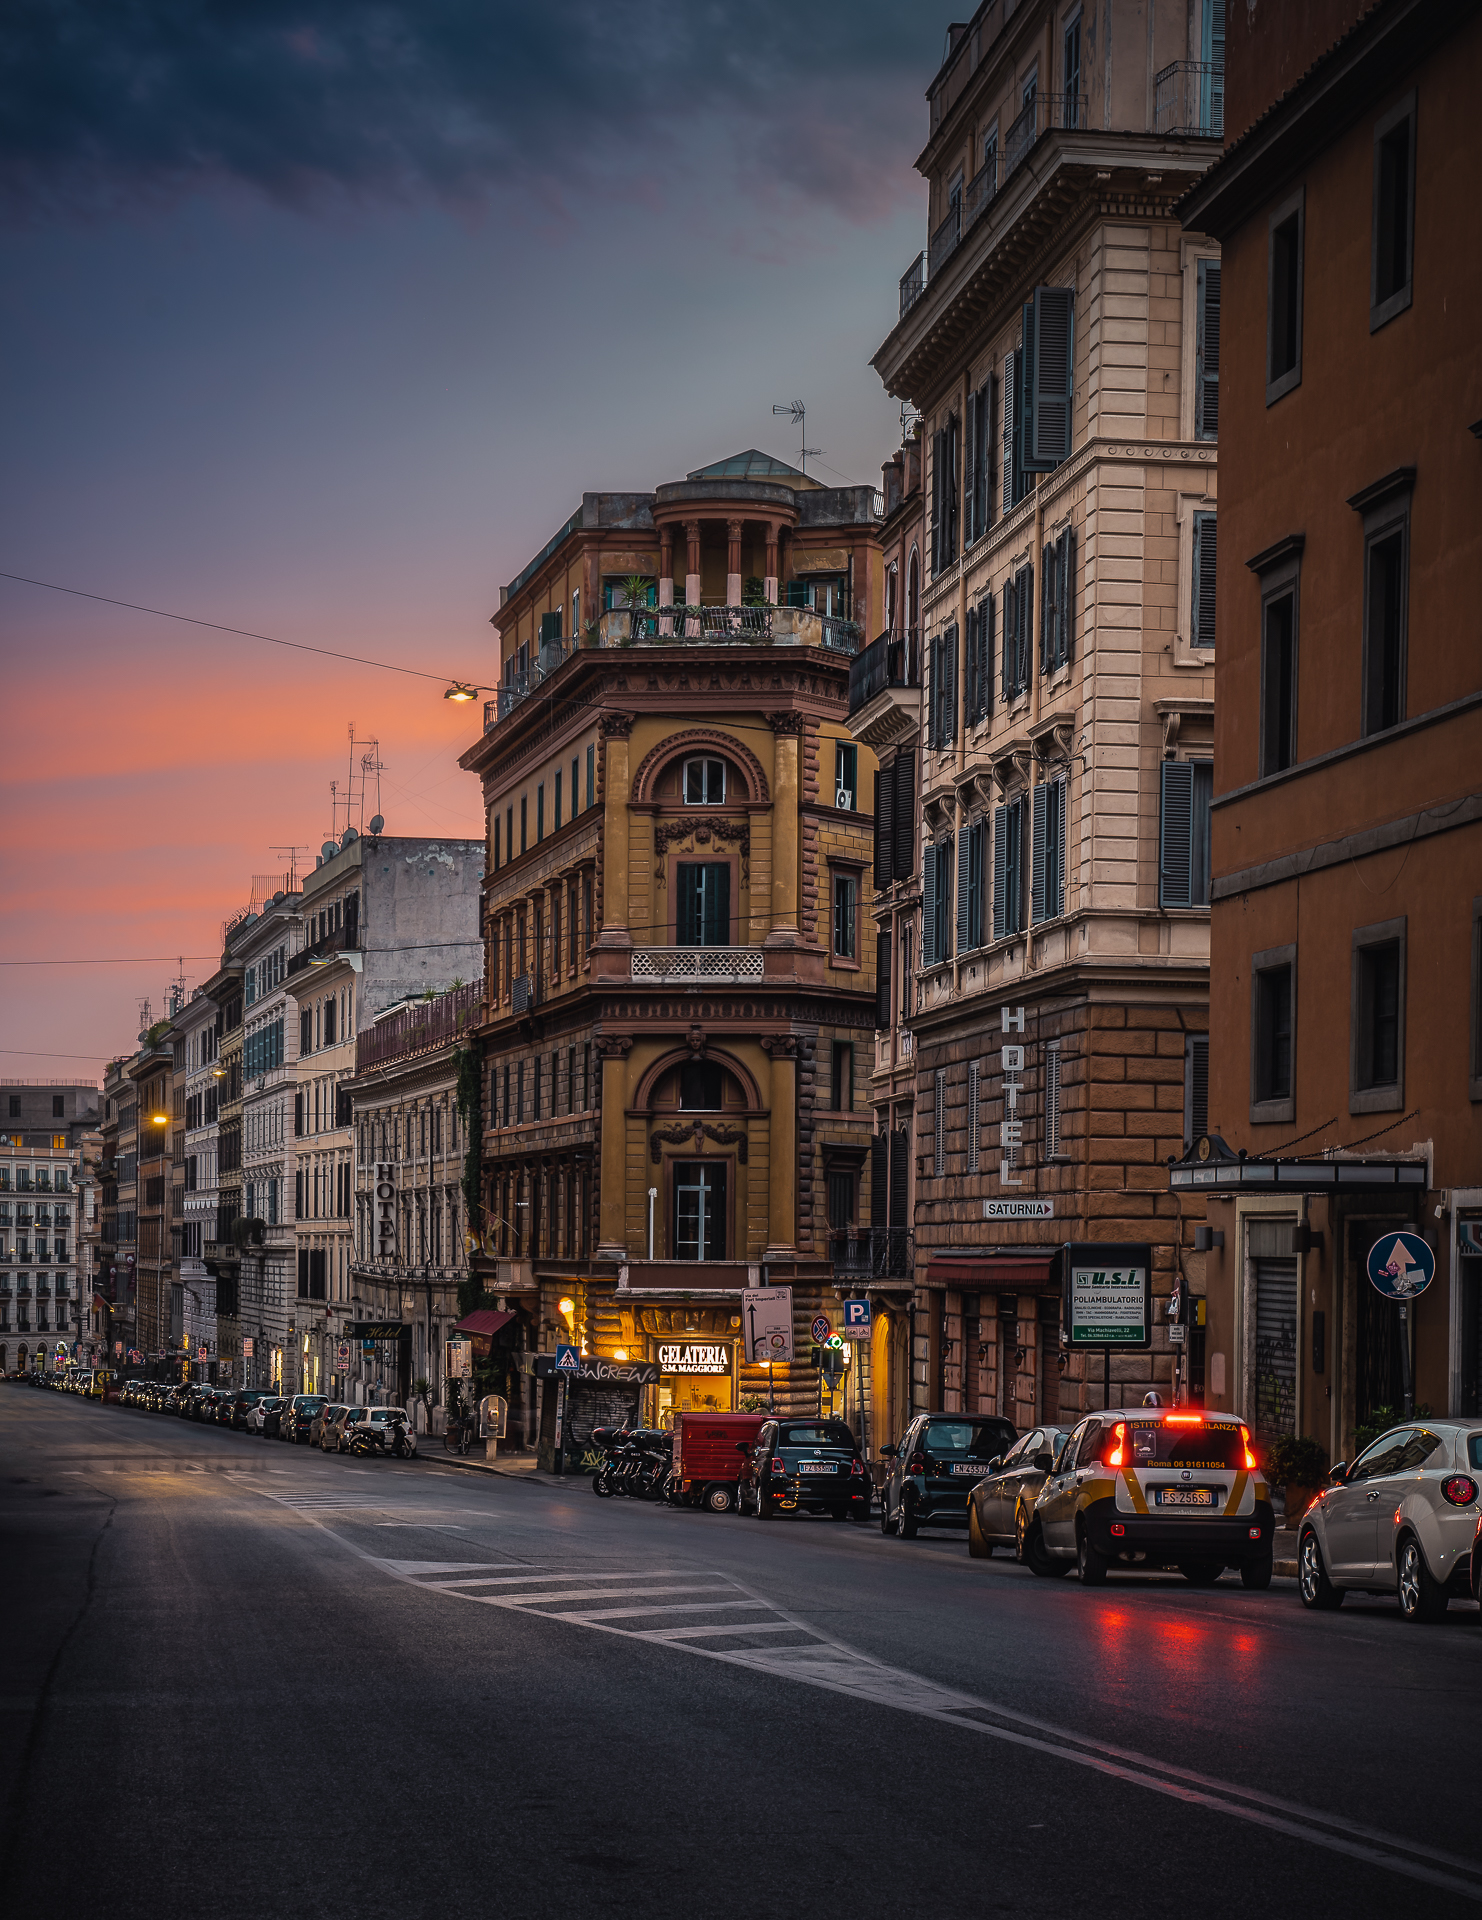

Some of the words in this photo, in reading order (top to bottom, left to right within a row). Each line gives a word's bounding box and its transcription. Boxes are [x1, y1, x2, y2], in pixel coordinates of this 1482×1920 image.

[1001, 1006, 1025, 1186] HOTEL
[376, 1164, 394, 1256] HOTEL
[988, 1203, 1043, 1215] SATURNIA
[1074, 1296, 1143, 1304] POLIAMBULATORIO
[850, 1304, 864, 1323] P
[365, 1326, 402, 1338] Hotel
[658, 1345, 728, 1364] GELATERIA
[662, 1364, 679, 1373] S.M.
[682, 1364, 725, 1373] MAGGIORE
[1130, 1421, 1174, 1429] ISTITUTO
[1188, 1422, 1238, 1432] VIGILANZA
[1173, 1460, 1184, 1468] 06
[1186, 1460, 1225, 1469] 91611054
